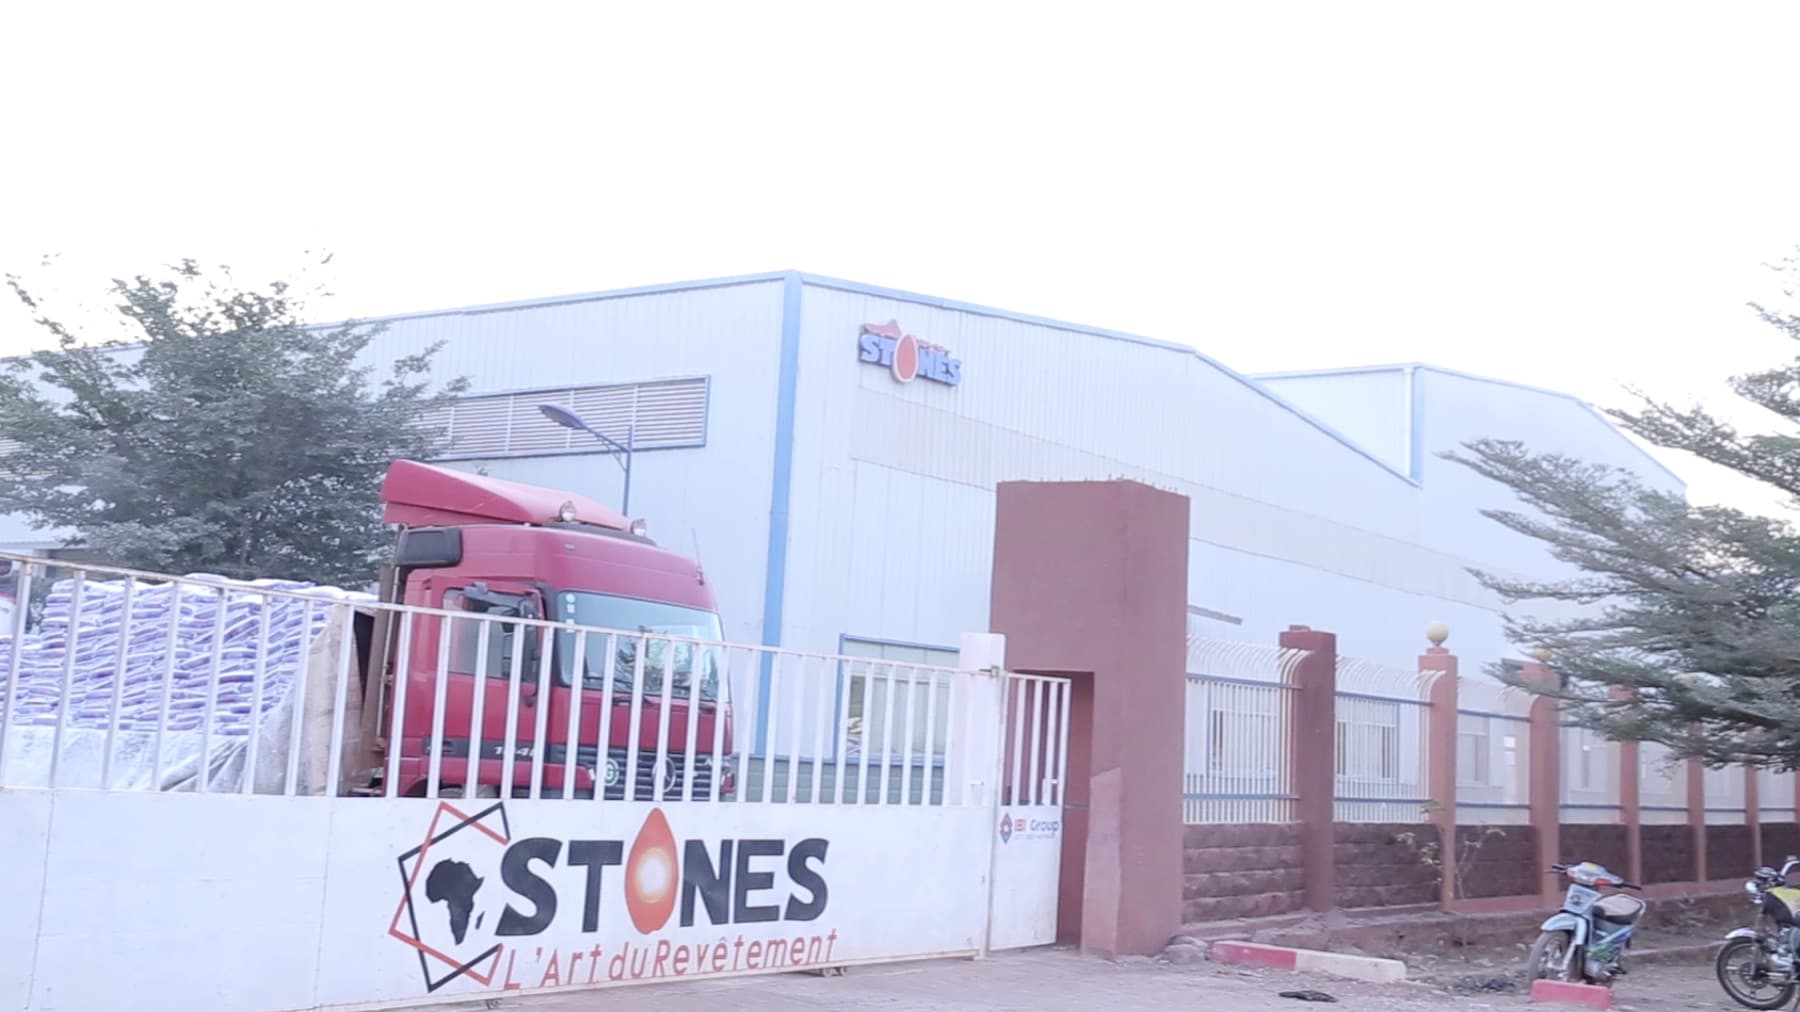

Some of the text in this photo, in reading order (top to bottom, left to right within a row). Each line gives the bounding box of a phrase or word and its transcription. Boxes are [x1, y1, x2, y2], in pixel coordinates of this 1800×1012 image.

[858, 332, 961, 386] STONES
[1030, 818, 1059, 837] Group
[494, 807, 829, 936] STONES
